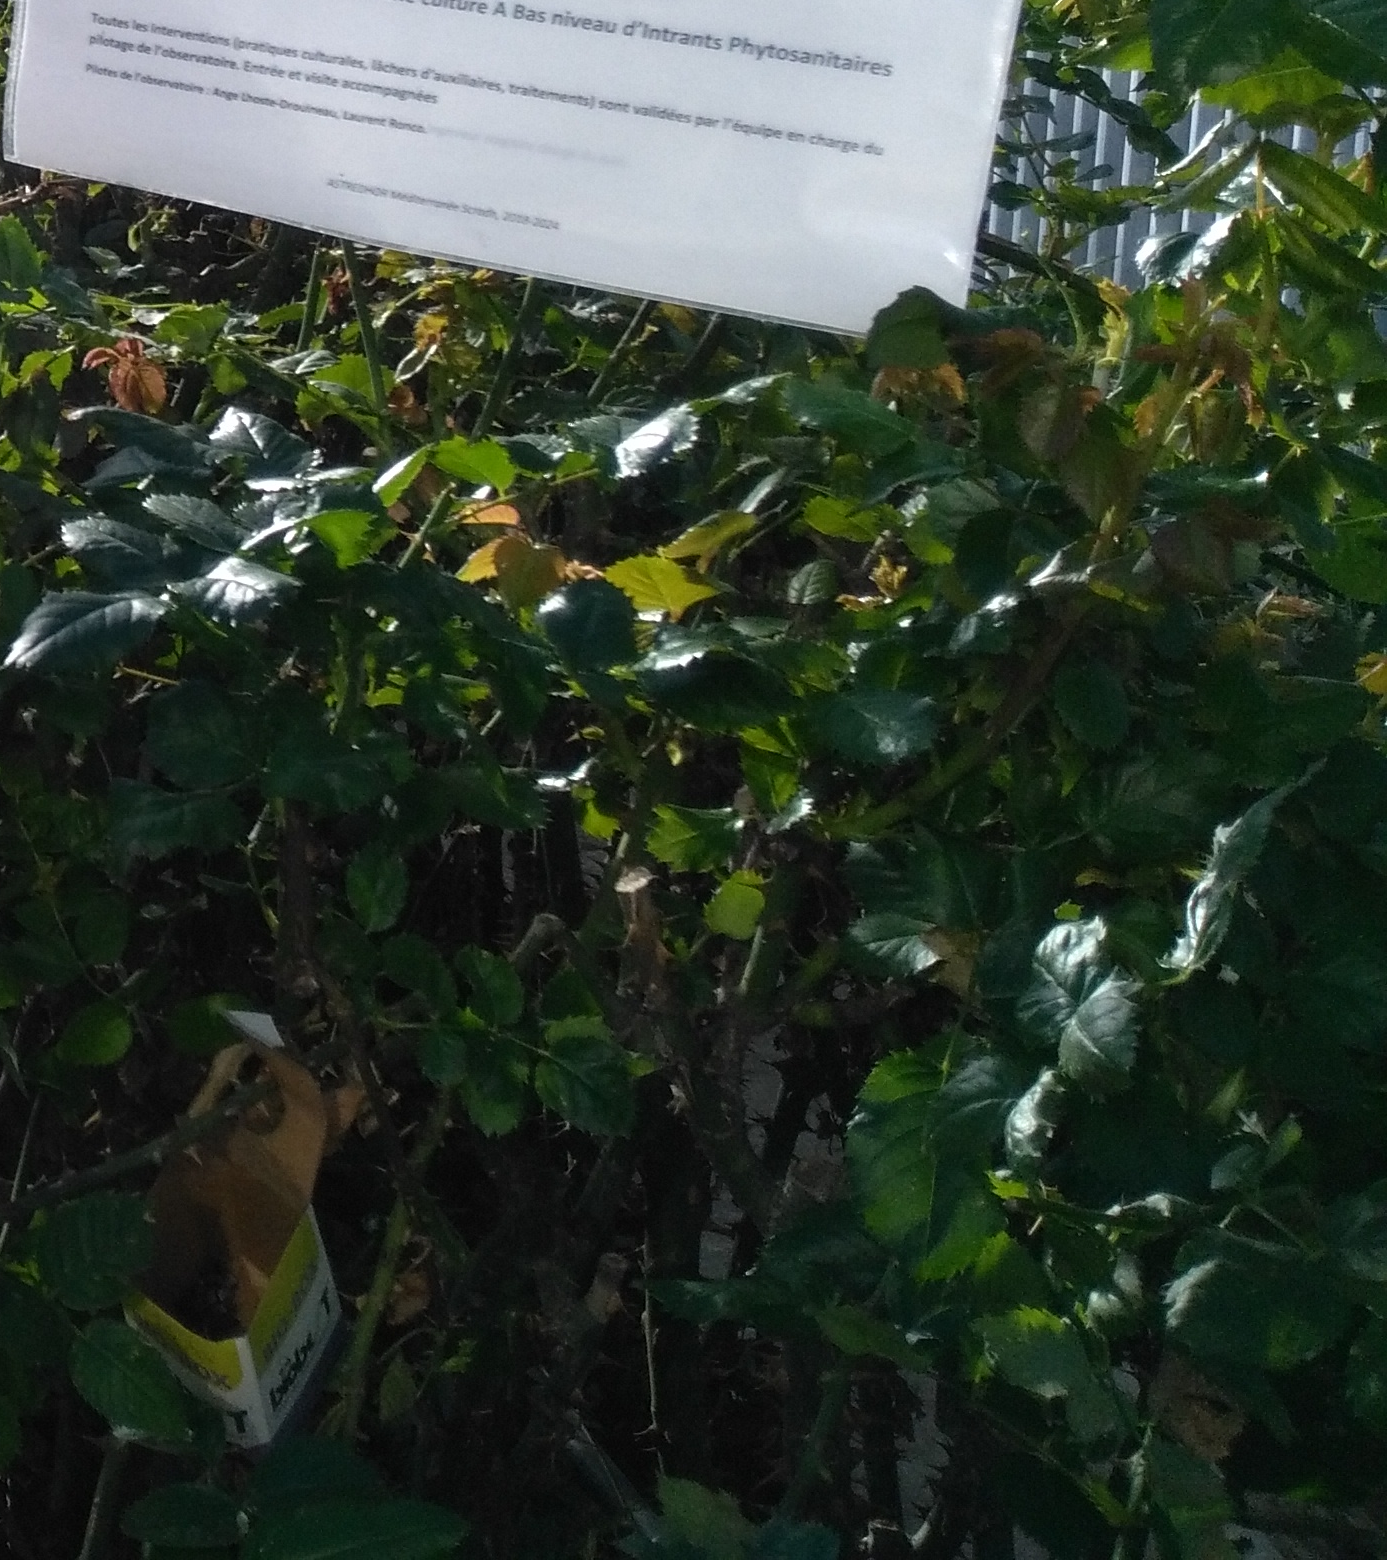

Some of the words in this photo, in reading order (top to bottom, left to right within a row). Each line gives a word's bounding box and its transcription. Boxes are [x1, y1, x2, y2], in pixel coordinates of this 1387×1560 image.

[85, 62, 118, 80] Pilotes
[120, 69, 133, 83] de
[89, 33, 134, 53] pilotage
[136, 40, 152, 55] de
[243, 60, 285, 79] Entrée
[288, 69, 302, 83] et
[304, 71, 338, 89] visite
[341, 77, 439, 105] accompagnées
[492, 1, 508, 18] A
[512, 4, 546, 24] Bas
[550, 11, 617, 35] niveau
[727, 36, 895, 78] Phytosanitaires
[91, 12, 130, 29] Toutes
[132, 19, 149, 33] les
[150, 22, 231, 48] interventions
[233, 37, 298, 60] (pratiques
[371, 58, 418, 79] lâchers
[509, 82, 595, 110] traitements)
[598, 96, 630, 114] sont
[632, 103, 692, 125] validées
[694, 113, 720, 130] par
[786, 130, 806, 144] en
[809, 132, 860, 154] charge
[863, 140, 884, 157] du
